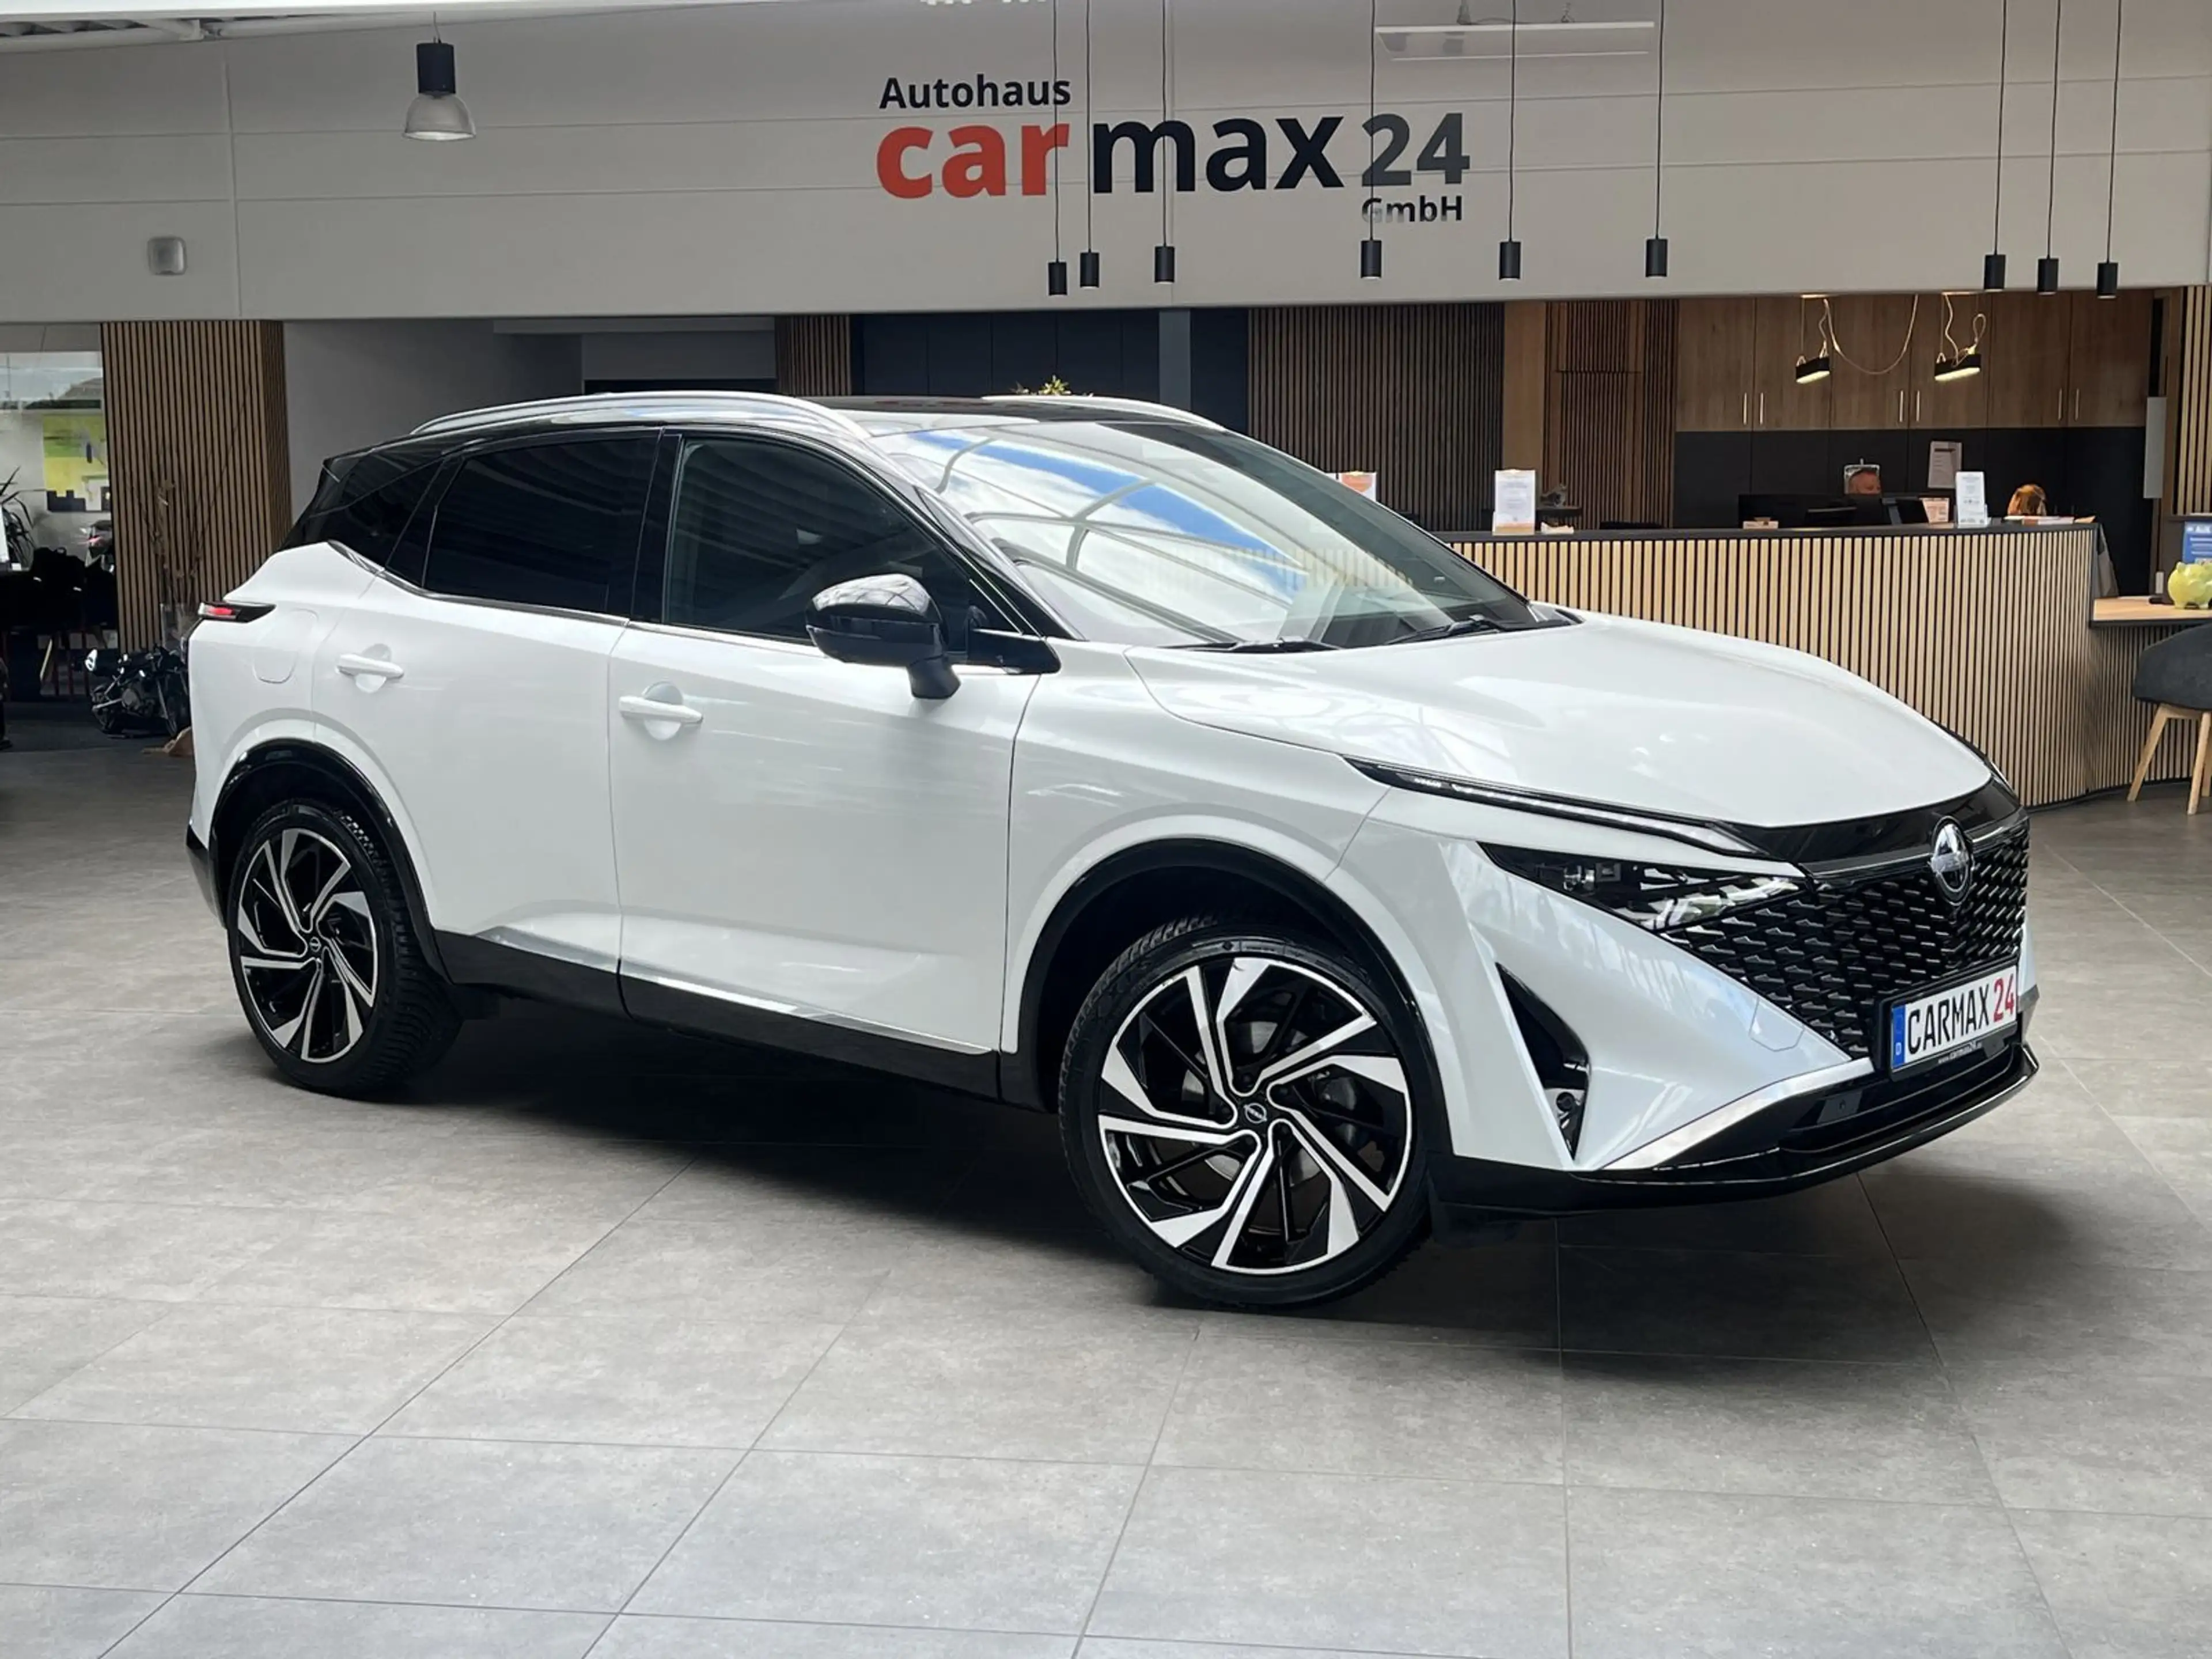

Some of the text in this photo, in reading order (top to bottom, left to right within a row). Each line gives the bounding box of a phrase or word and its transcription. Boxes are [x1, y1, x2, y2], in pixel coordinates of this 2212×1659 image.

[879, 74, 1070, 109] Autohaus
[1361, 112, 1471, 187] 24
[1362, 195, 1463, 224] GmbH
[1907, 983, 1989, 1054] CARMAX
[1993, 974, 2015, 1022] 24
